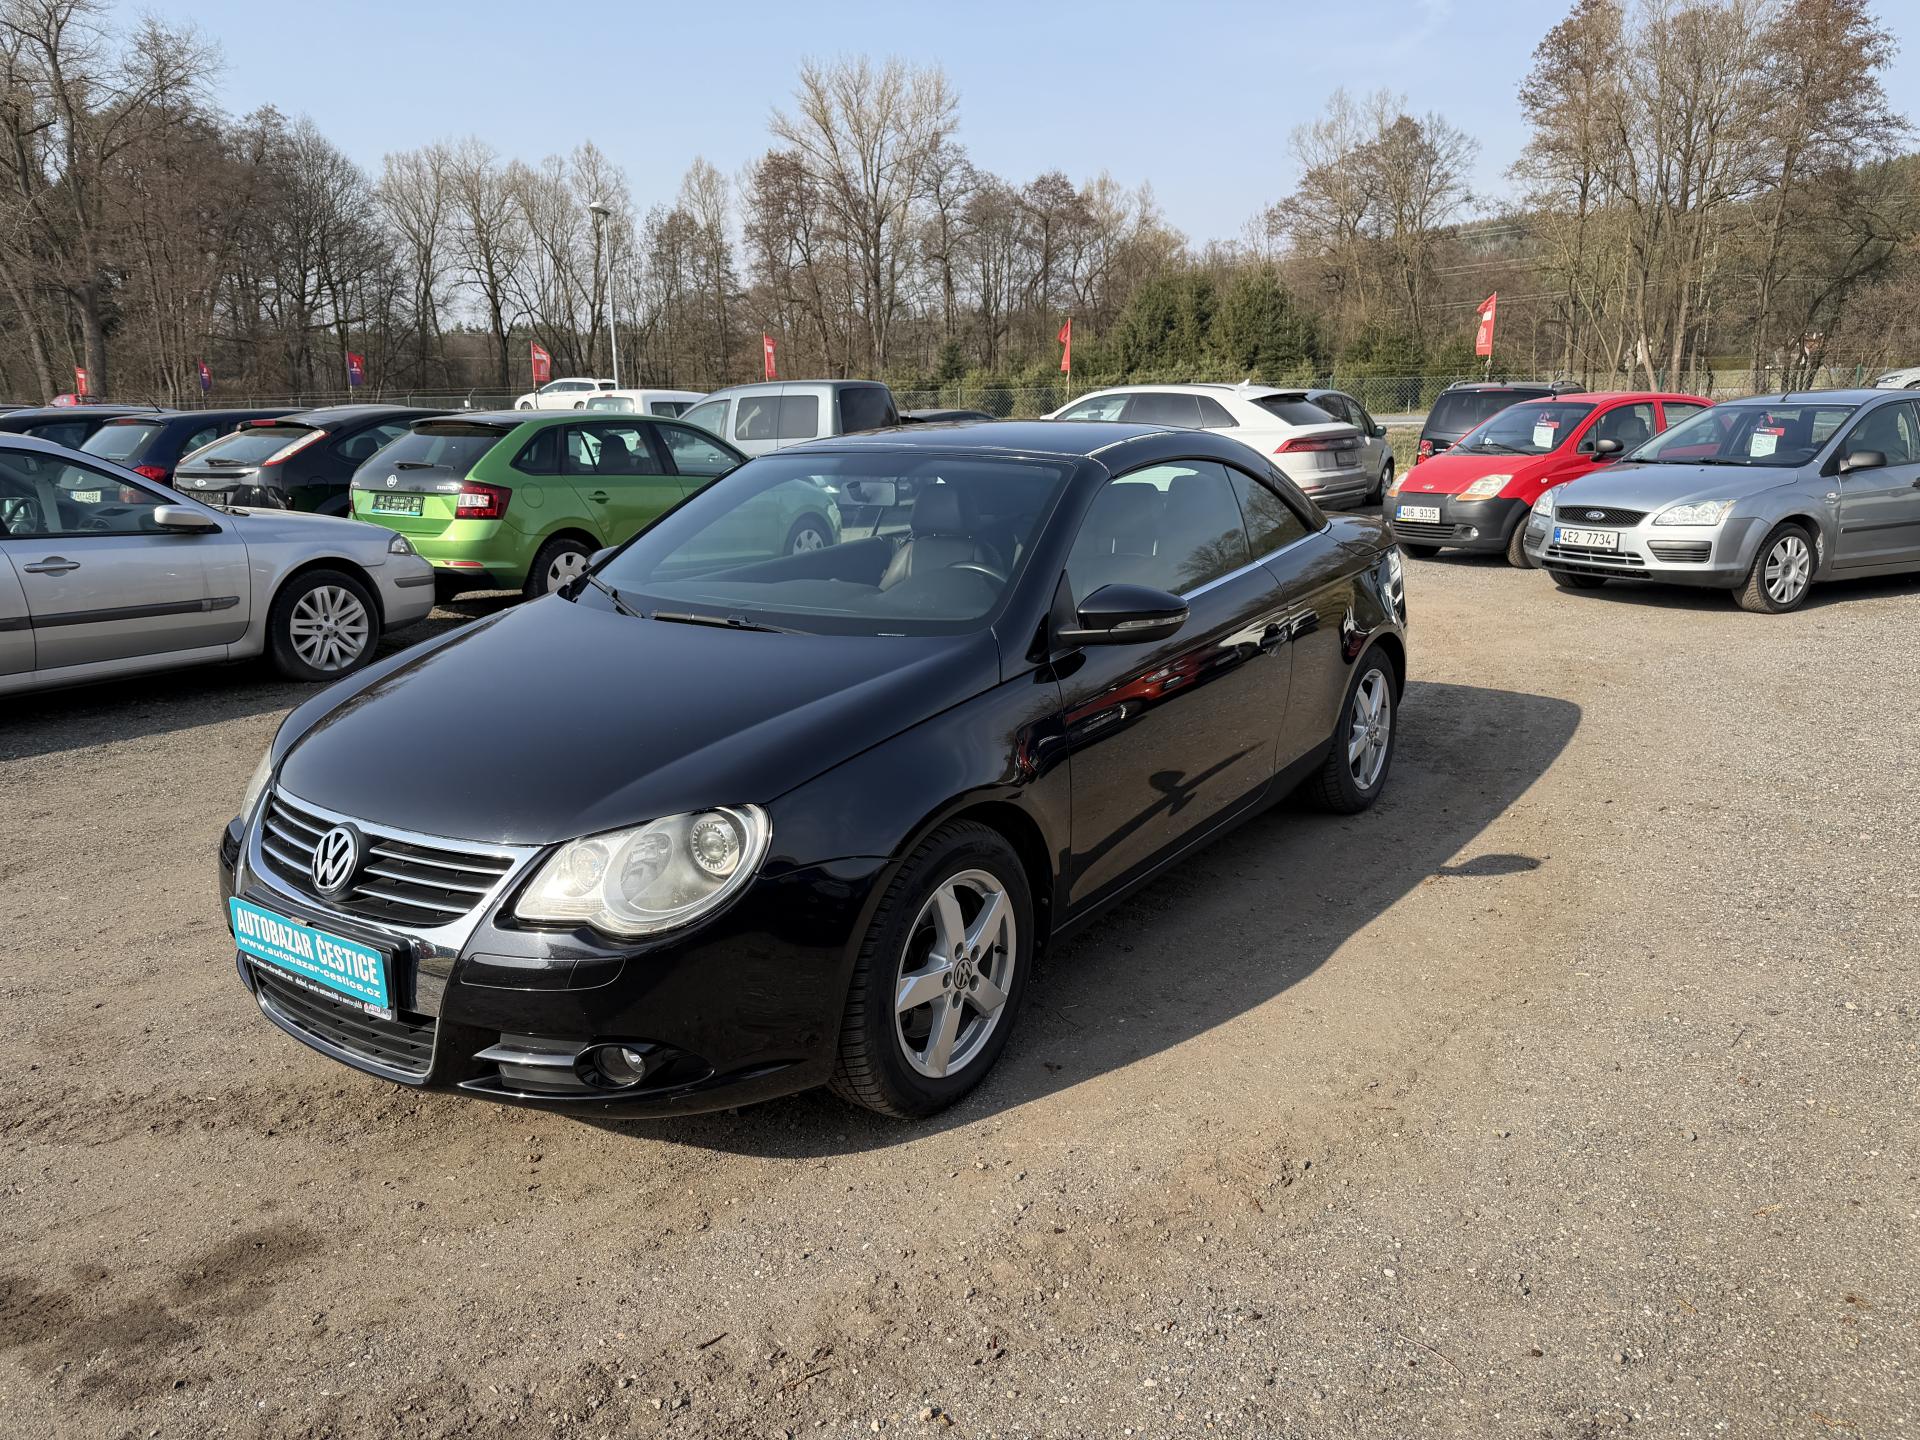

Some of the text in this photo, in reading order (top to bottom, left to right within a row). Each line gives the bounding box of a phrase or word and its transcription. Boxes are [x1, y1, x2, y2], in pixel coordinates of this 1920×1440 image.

[1402, 507, 1436, 519] 4U6 9335
[1562, 530, 1611, 546] 4E2 7734
[236, 907, 314, 960] AUTOBAZAR
[315, 933, 380, 986] ČESTICE
[240, 936, 381, 999] www.autobazar-cestice.cz
